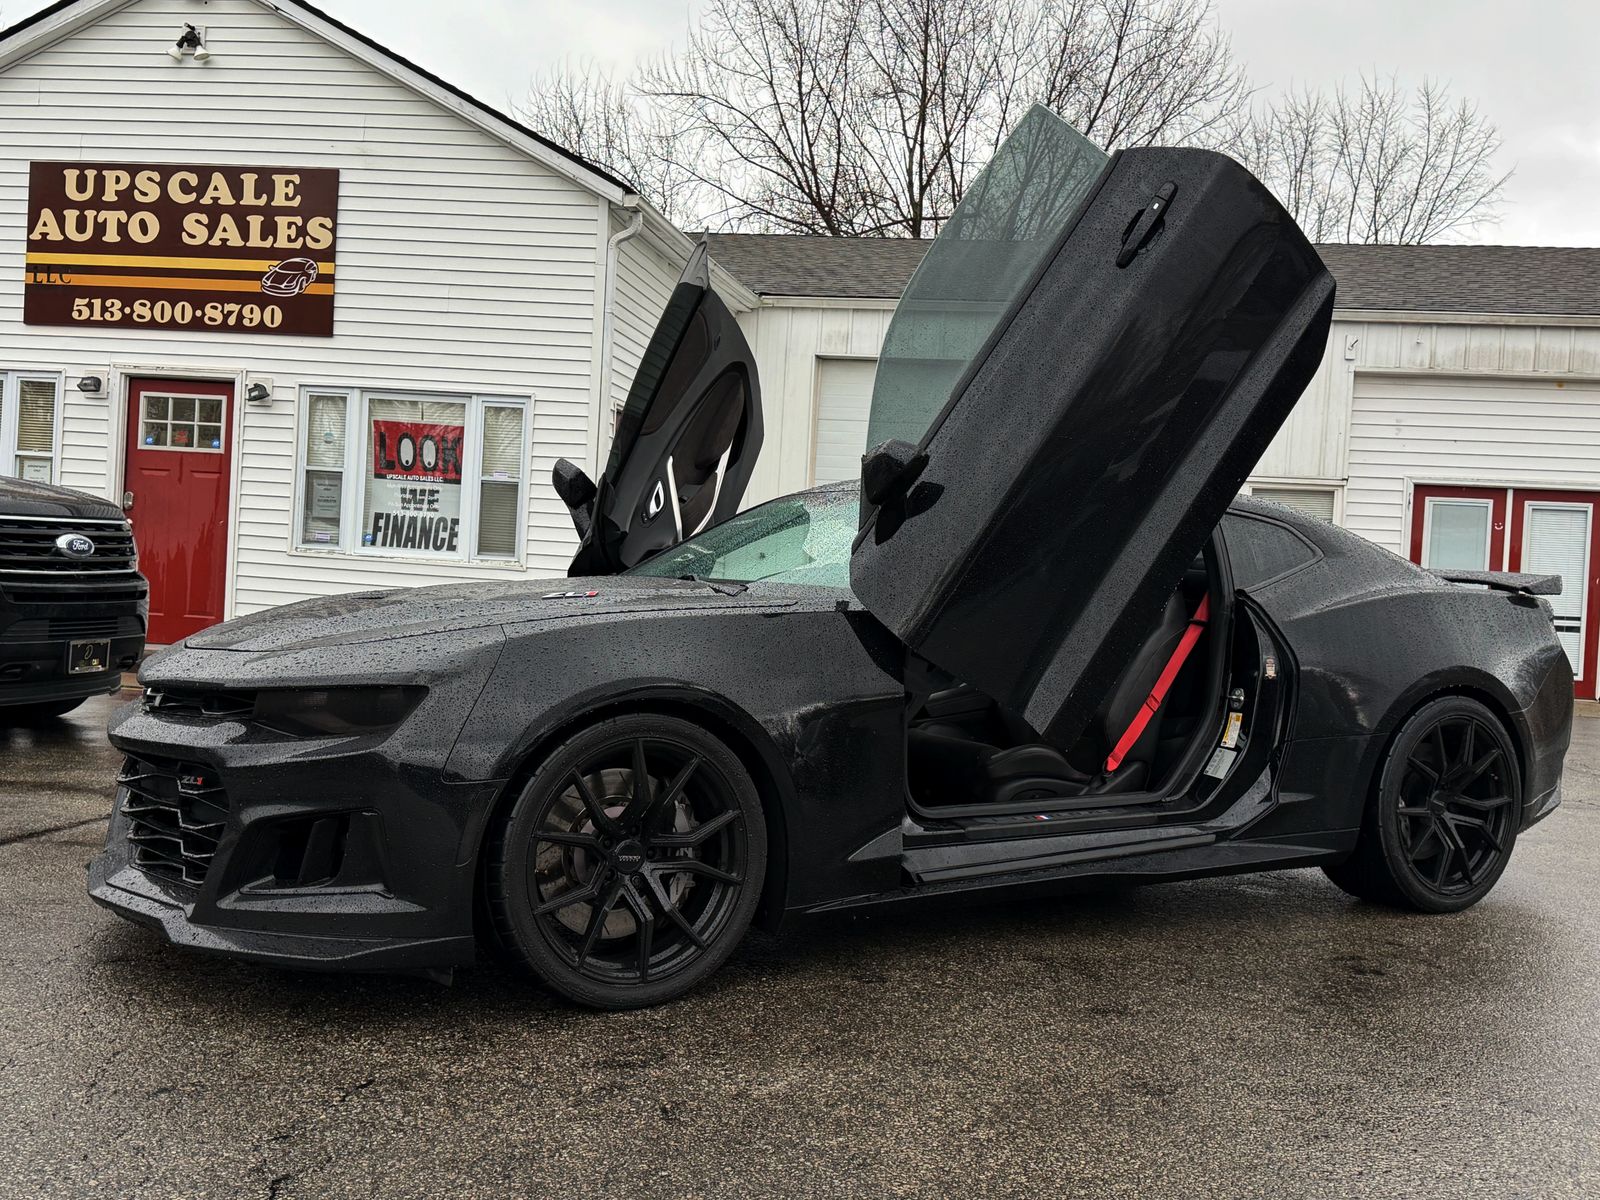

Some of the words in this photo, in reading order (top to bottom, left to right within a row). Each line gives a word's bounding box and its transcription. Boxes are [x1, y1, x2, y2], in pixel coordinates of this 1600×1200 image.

[63, 168, 301, 207] UPSCALE
[29, 208, 160, 244] AUTO
[182, 213, 334, 249] SALES
[33, 266, 71, 284] LLC
[379, 431, 463, 475] LOOK
[72, 539, 89, 552] Ford
[370, 511, 460, 551] FINANCE
